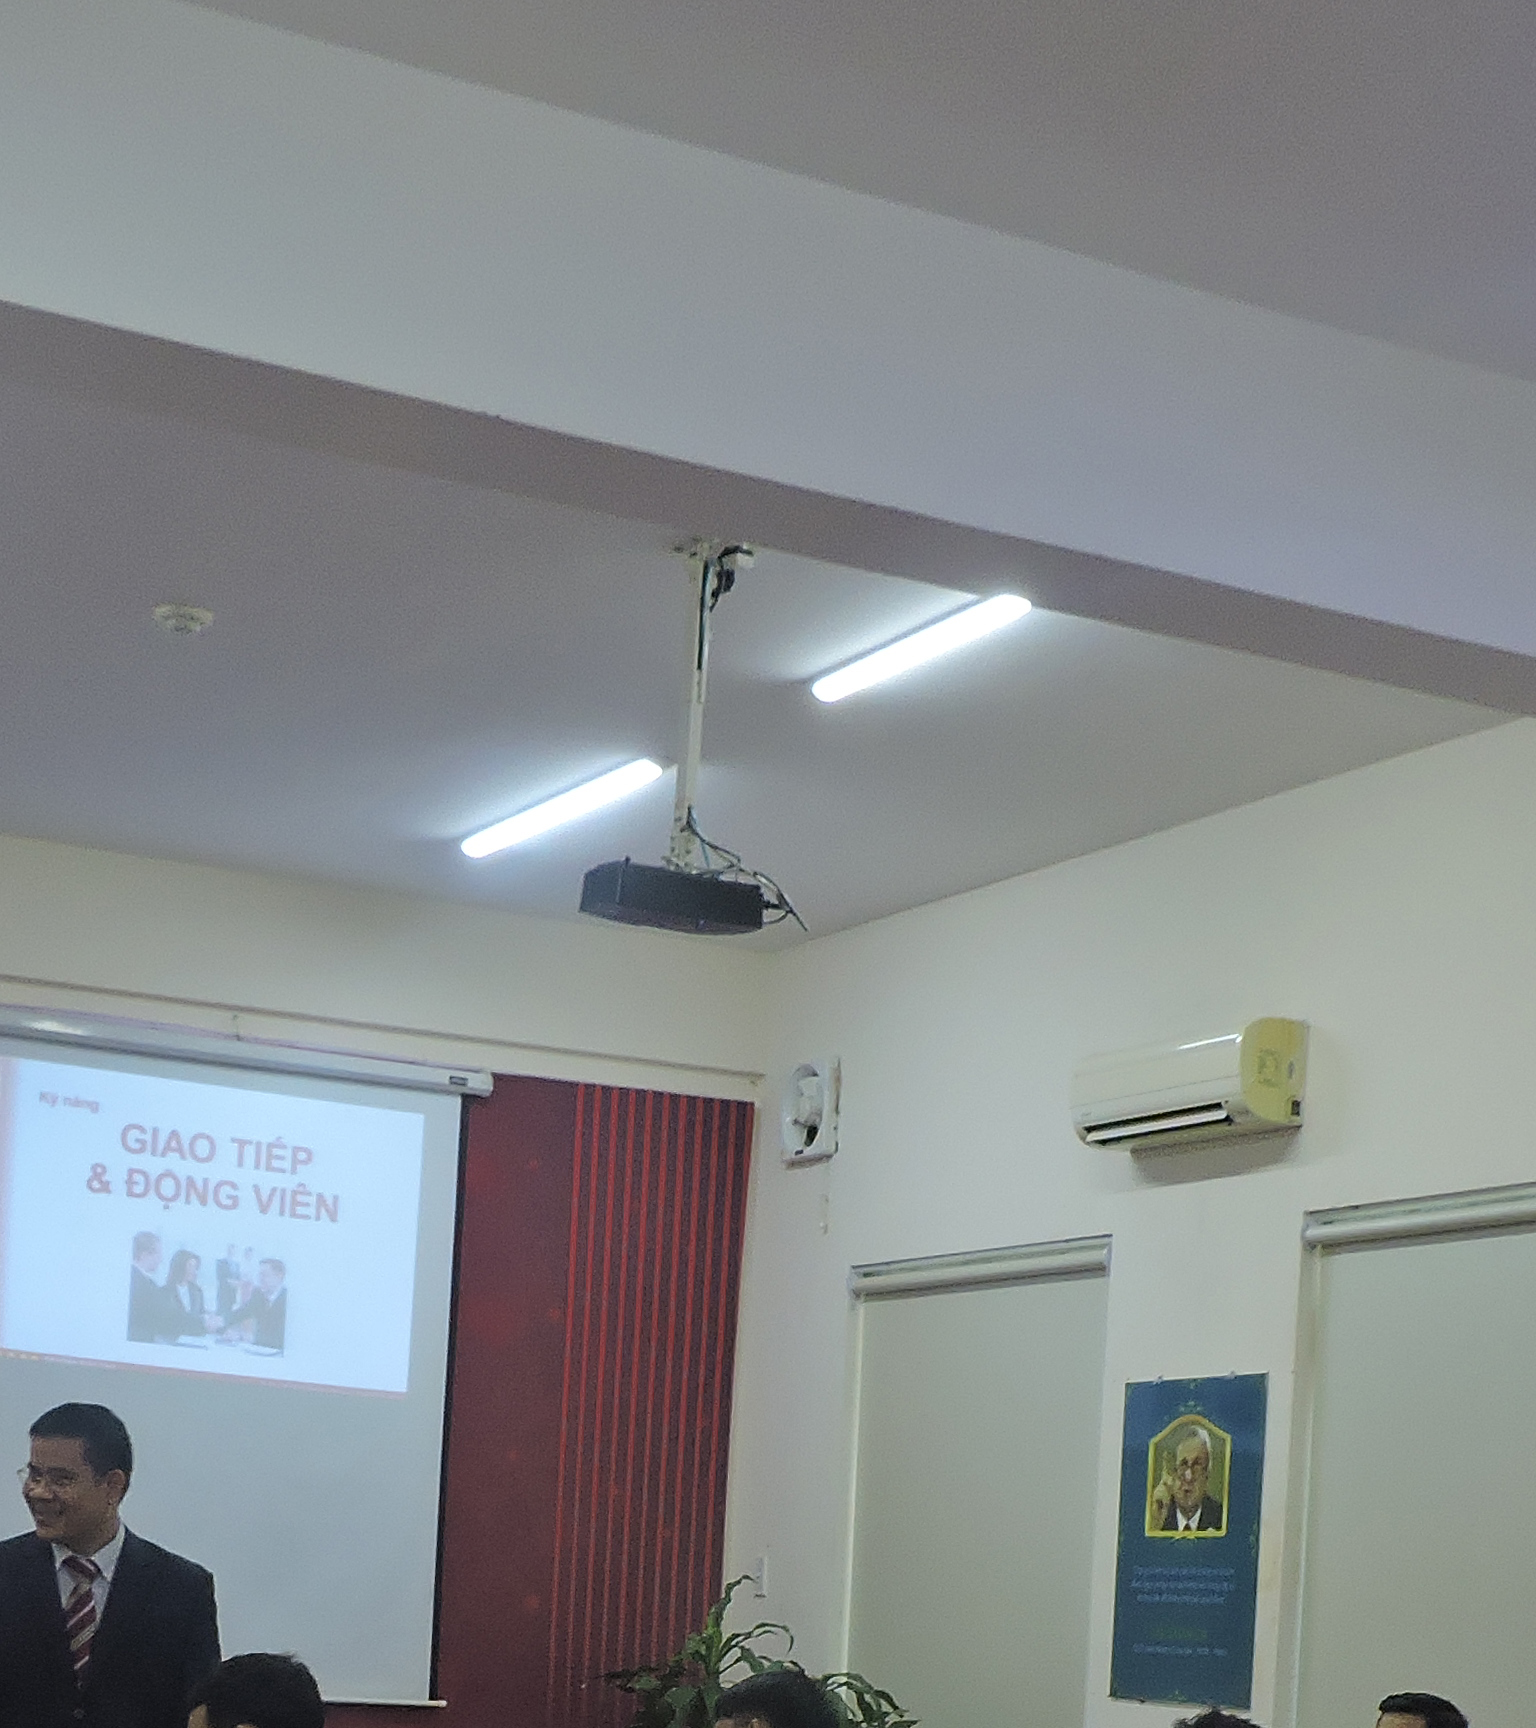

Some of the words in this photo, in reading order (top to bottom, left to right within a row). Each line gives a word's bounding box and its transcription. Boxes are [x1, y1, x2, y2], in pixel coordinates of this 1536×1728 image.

[120, 1122, 217, 1164] GIAO
[230, 1135, 314, 1175] TIẾP
[85, 1162, 113, 1195] &
[124, 1166, 240, 1211] ĐỘNG
[251, 1181, 341, 1224] VIÊN
